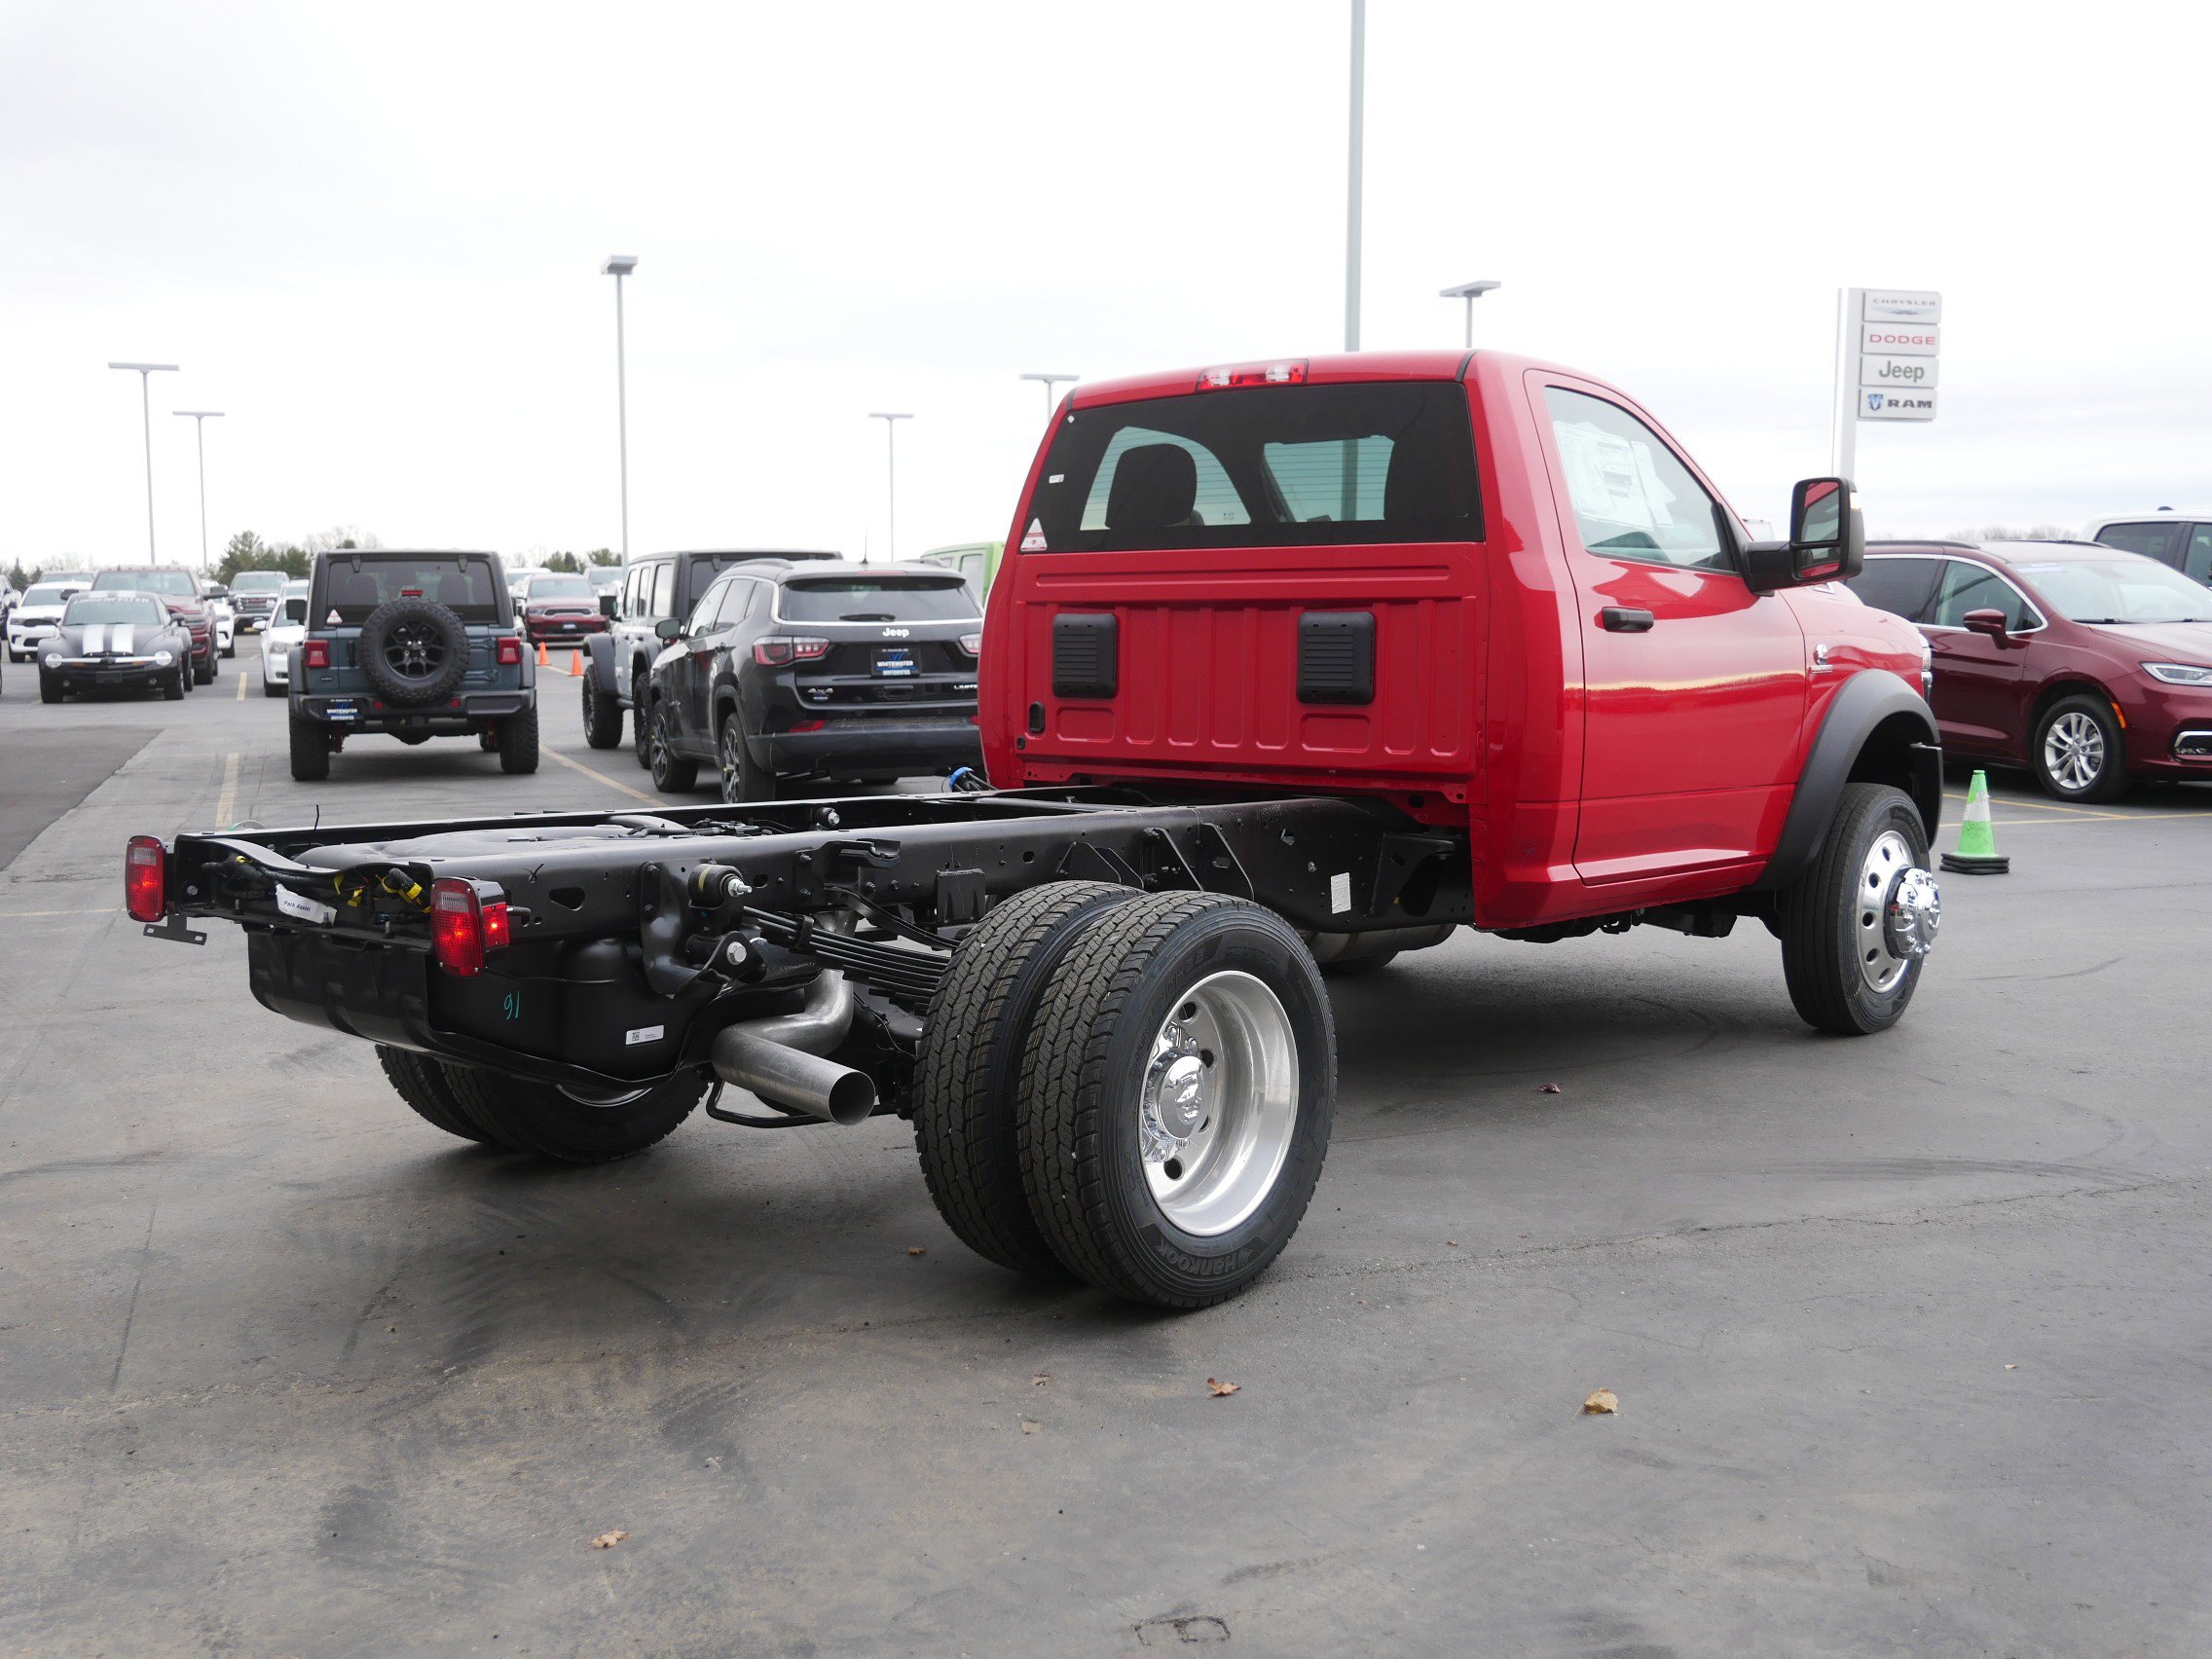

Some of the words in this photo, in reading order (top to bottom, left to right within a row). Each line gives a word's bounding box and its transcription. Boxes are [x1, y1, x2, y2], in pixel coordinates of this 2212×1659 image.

[1869, 334, 1936, 346] DODGE
[1878, 360, 1925, 383] Jeep
[1887, 399, 1933, 409] RAM
[882, 627, 910, 639] Jeep
[296, 903, 312, 912] Assist
